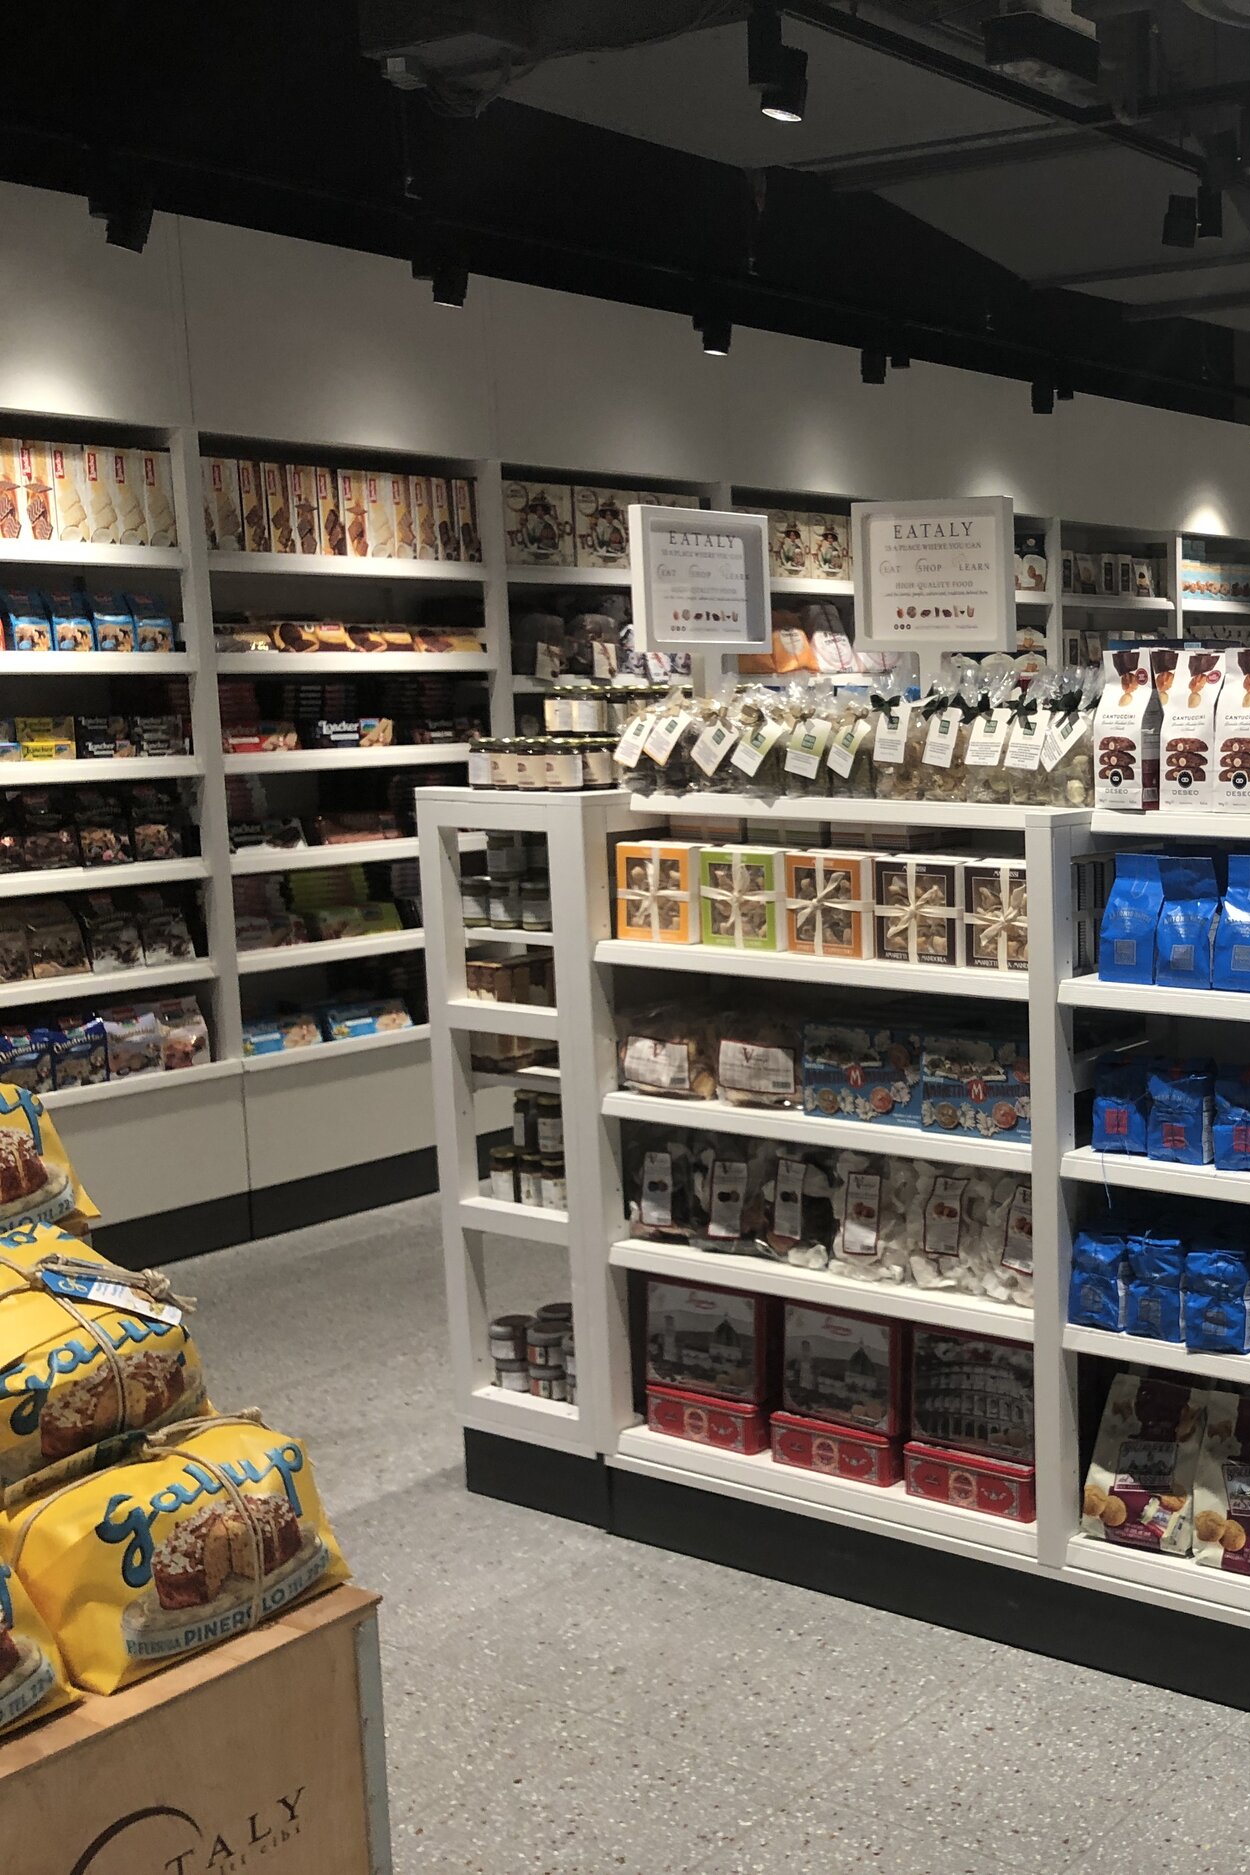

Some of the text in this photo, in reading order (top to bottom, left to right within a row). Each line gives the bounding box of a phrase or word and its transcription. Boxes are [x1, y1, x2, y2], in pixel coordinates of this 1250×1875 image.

[894, 522, 973, 539] EATALY
[669, 530, 736, 548] EATALY
[922, 543, 946, 551] WHERE
[918, 564, 942, 572] SHOP
[959, 563, 990, 571] LEARN
[318, 720, 359, 735] Loacker
